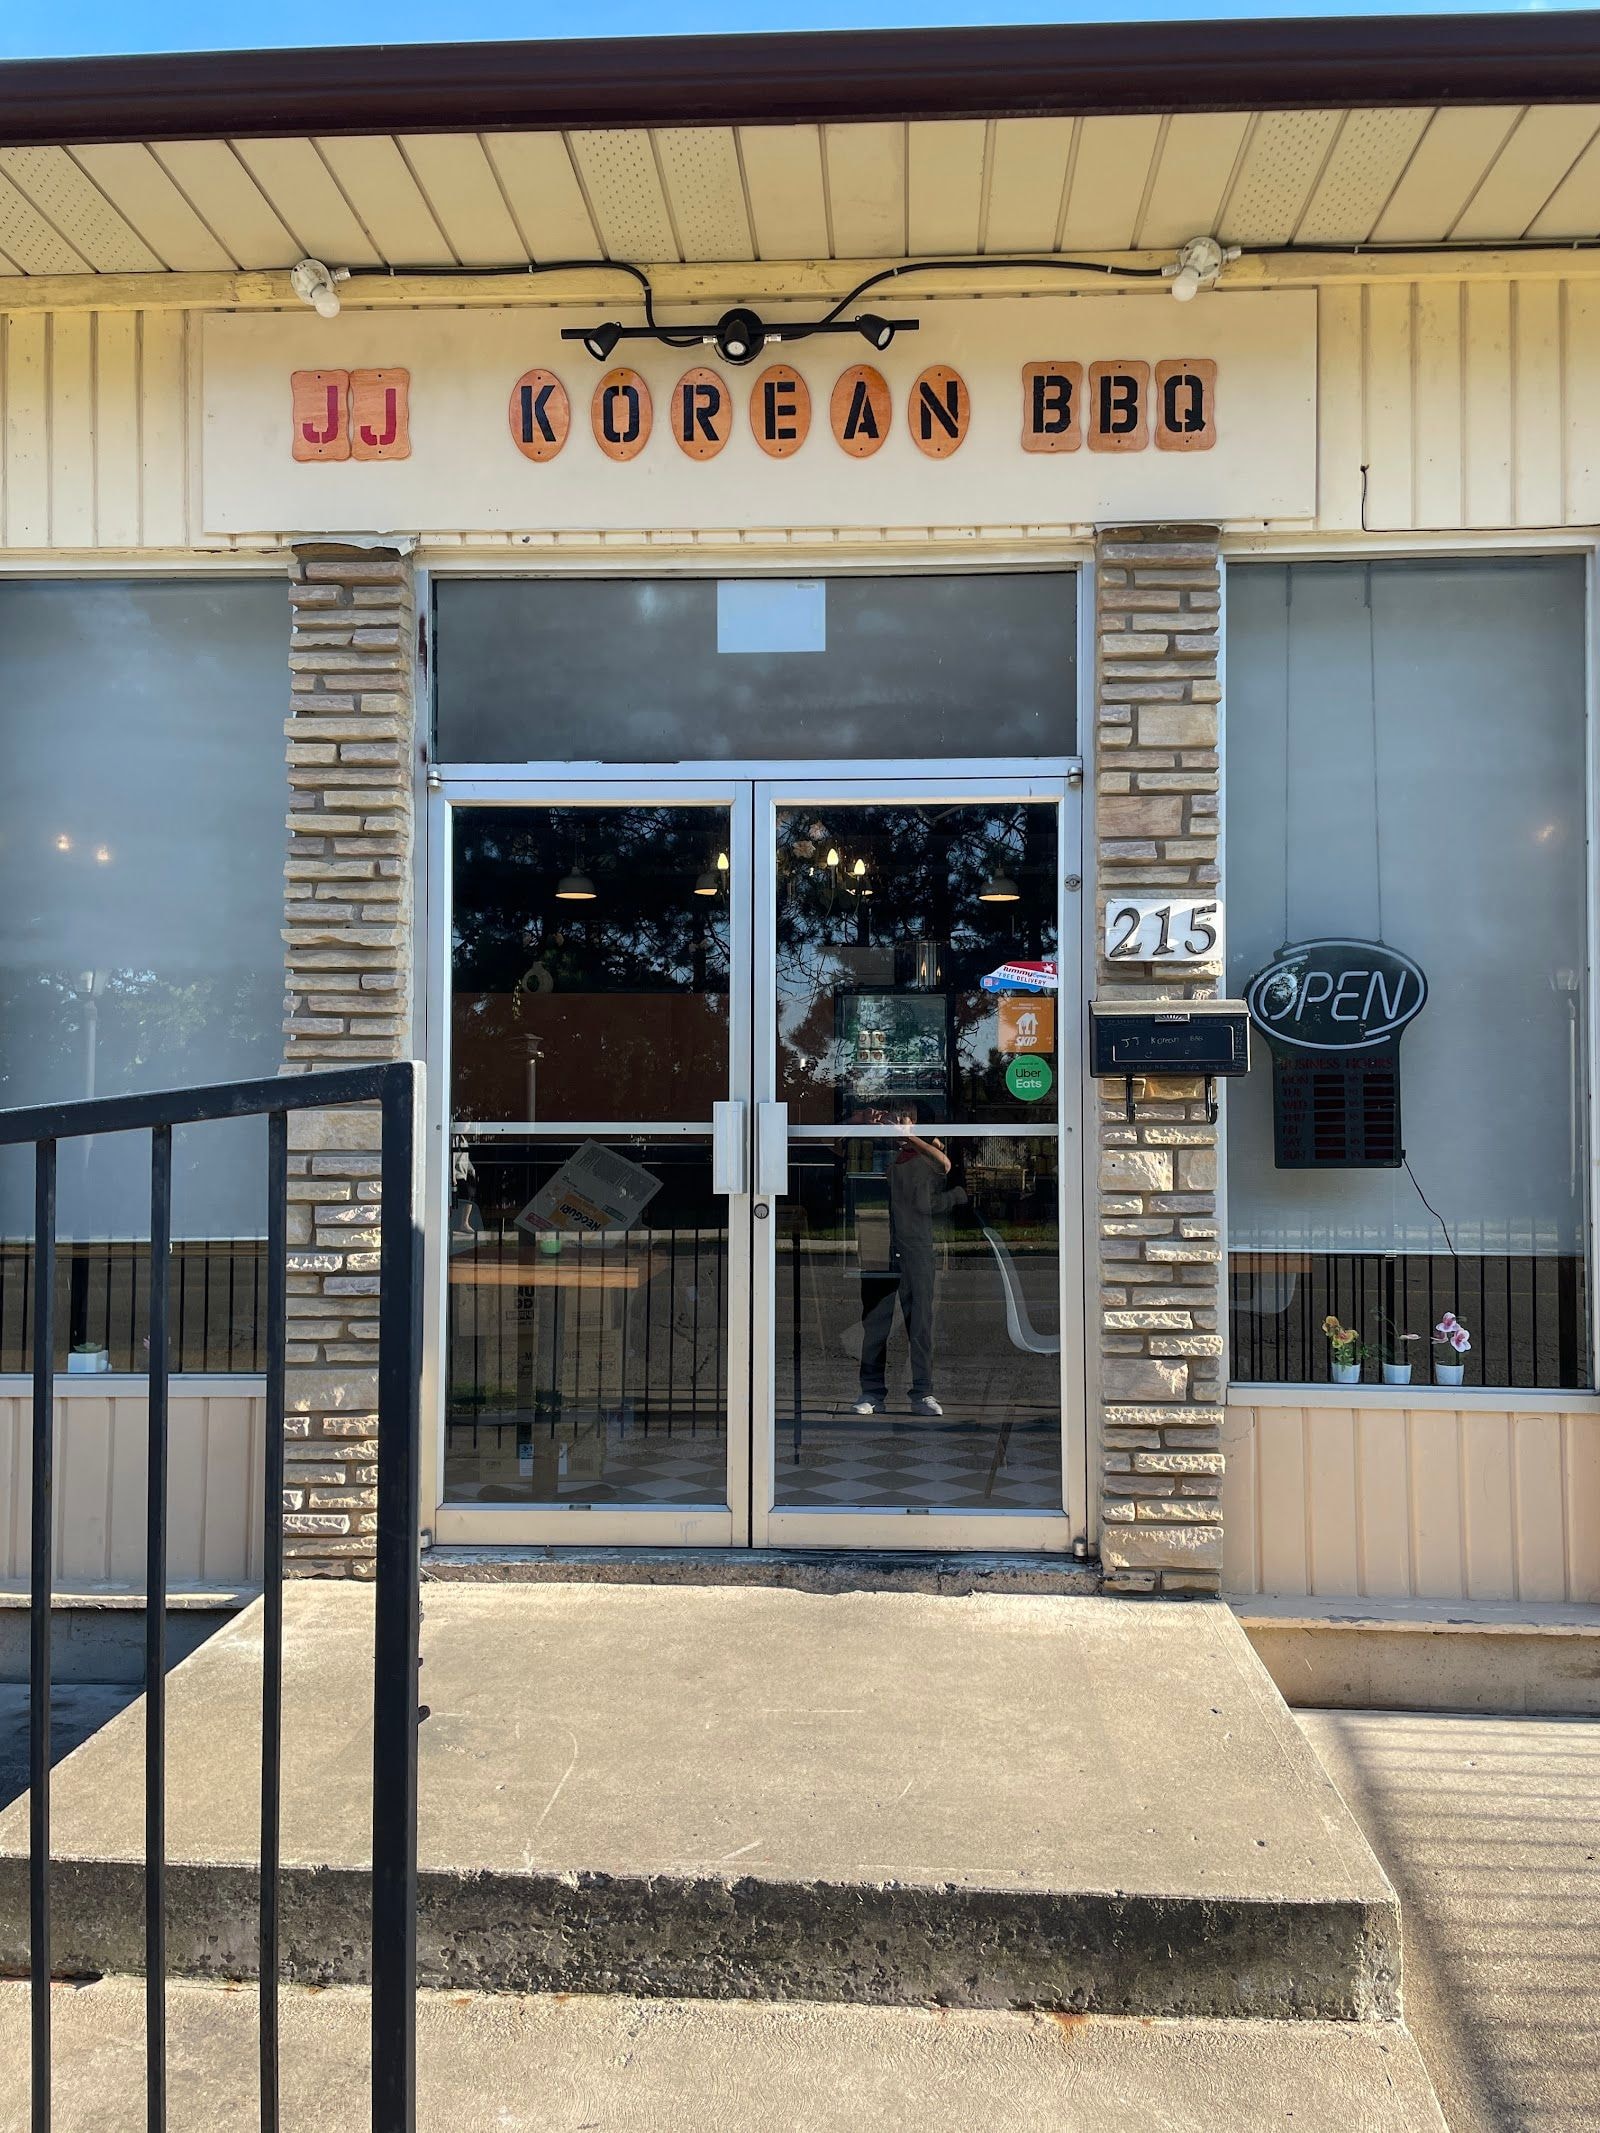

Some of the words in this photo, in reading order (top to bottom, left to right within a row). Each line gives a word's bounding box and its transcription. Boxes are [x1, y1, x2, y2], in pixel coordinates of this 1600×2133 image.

[302, 385, 397, 446] JJ
[521, 381, 959, 443] KOREAN
[1032, 374, 1206, 434] BBQ
[1109, 902, 1217, 957] 215
[1016, 975, 1047, 985] DELIVERY
[1260, 970, 1407, 1021] OPEN
[1015, 1036, 1037, 1047] SKIP
[1279, 1057, 1340, 1070] BUSINESS
[1345, 1057, 1393, 1069] HOURS
[1015, 1069, 1041, 1078] Uber
[1016, 1079, 1042, 1088] Eats
[559, 1203, 602, 1232] NEOGURI
